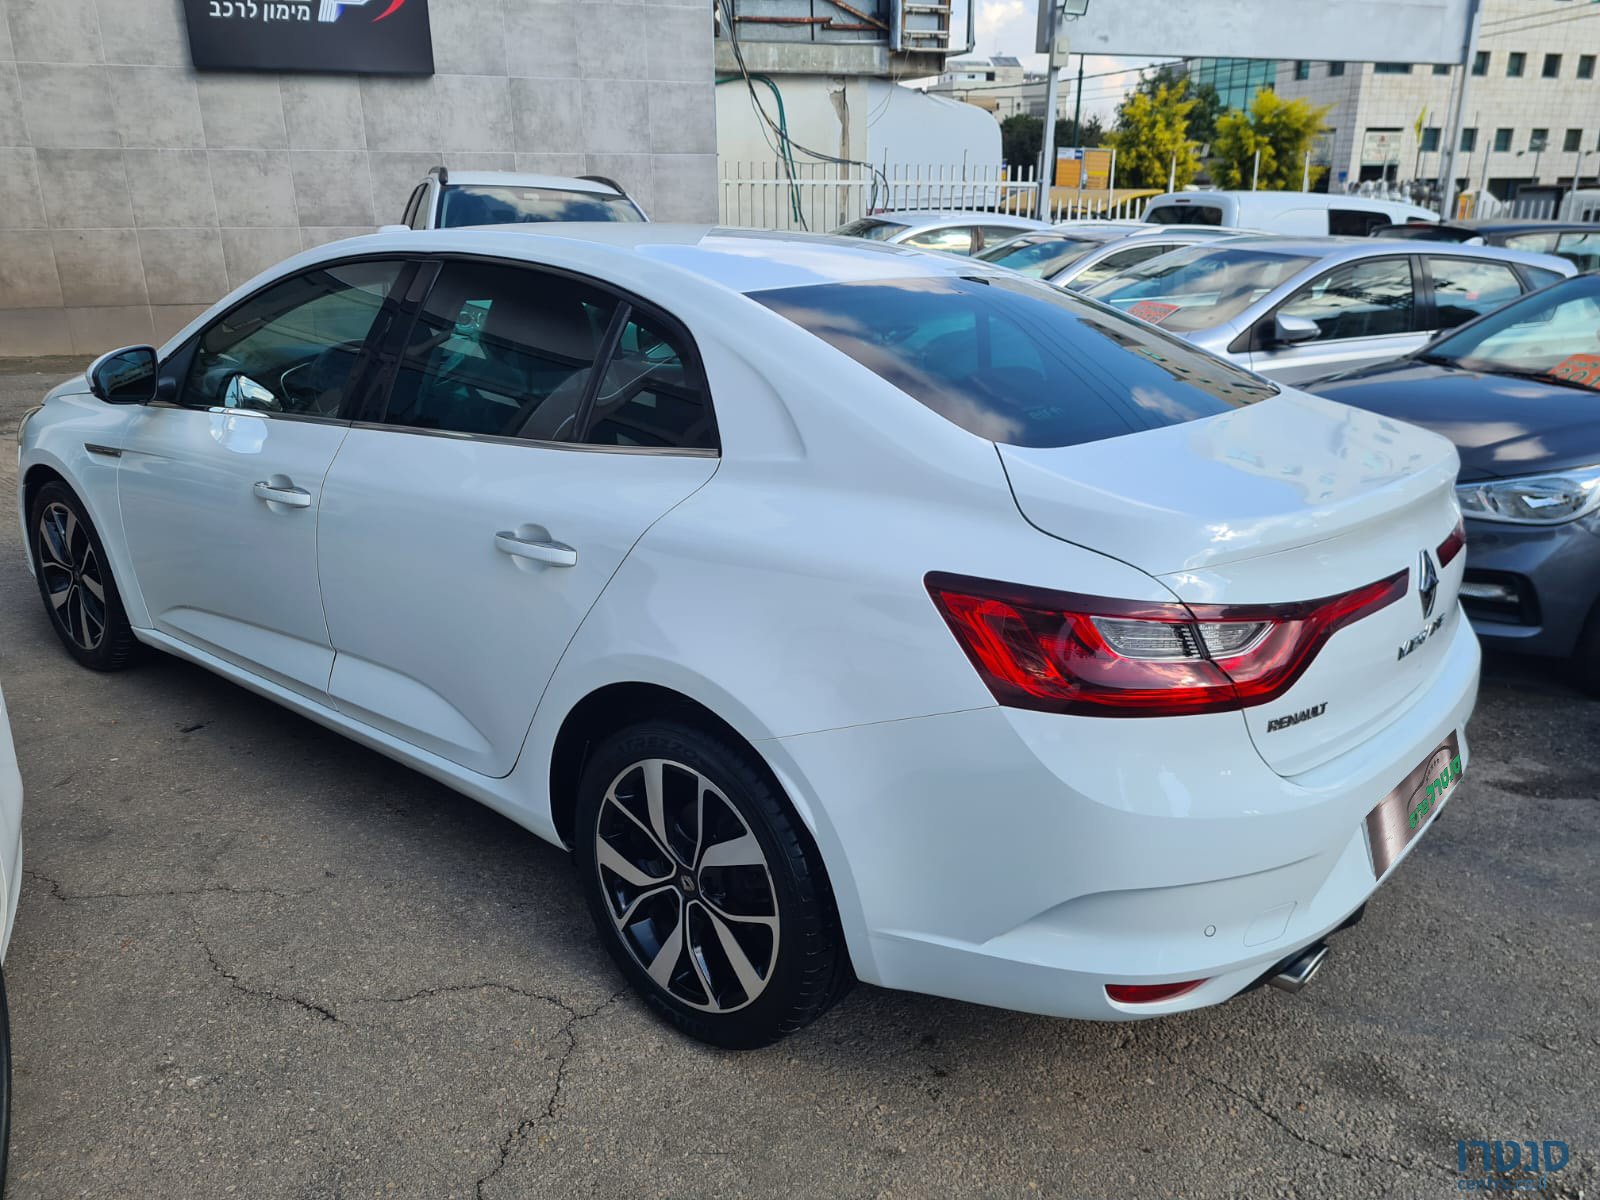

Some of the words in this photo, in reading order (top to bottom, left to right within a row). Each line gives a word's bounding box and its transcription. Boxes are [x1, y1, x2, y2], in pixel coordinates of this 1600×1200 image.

[209, 0, 258, 18] לרכב
[263, 3, 310, 22] מימון
[1266, 702, 1328, 733] RENAULT
